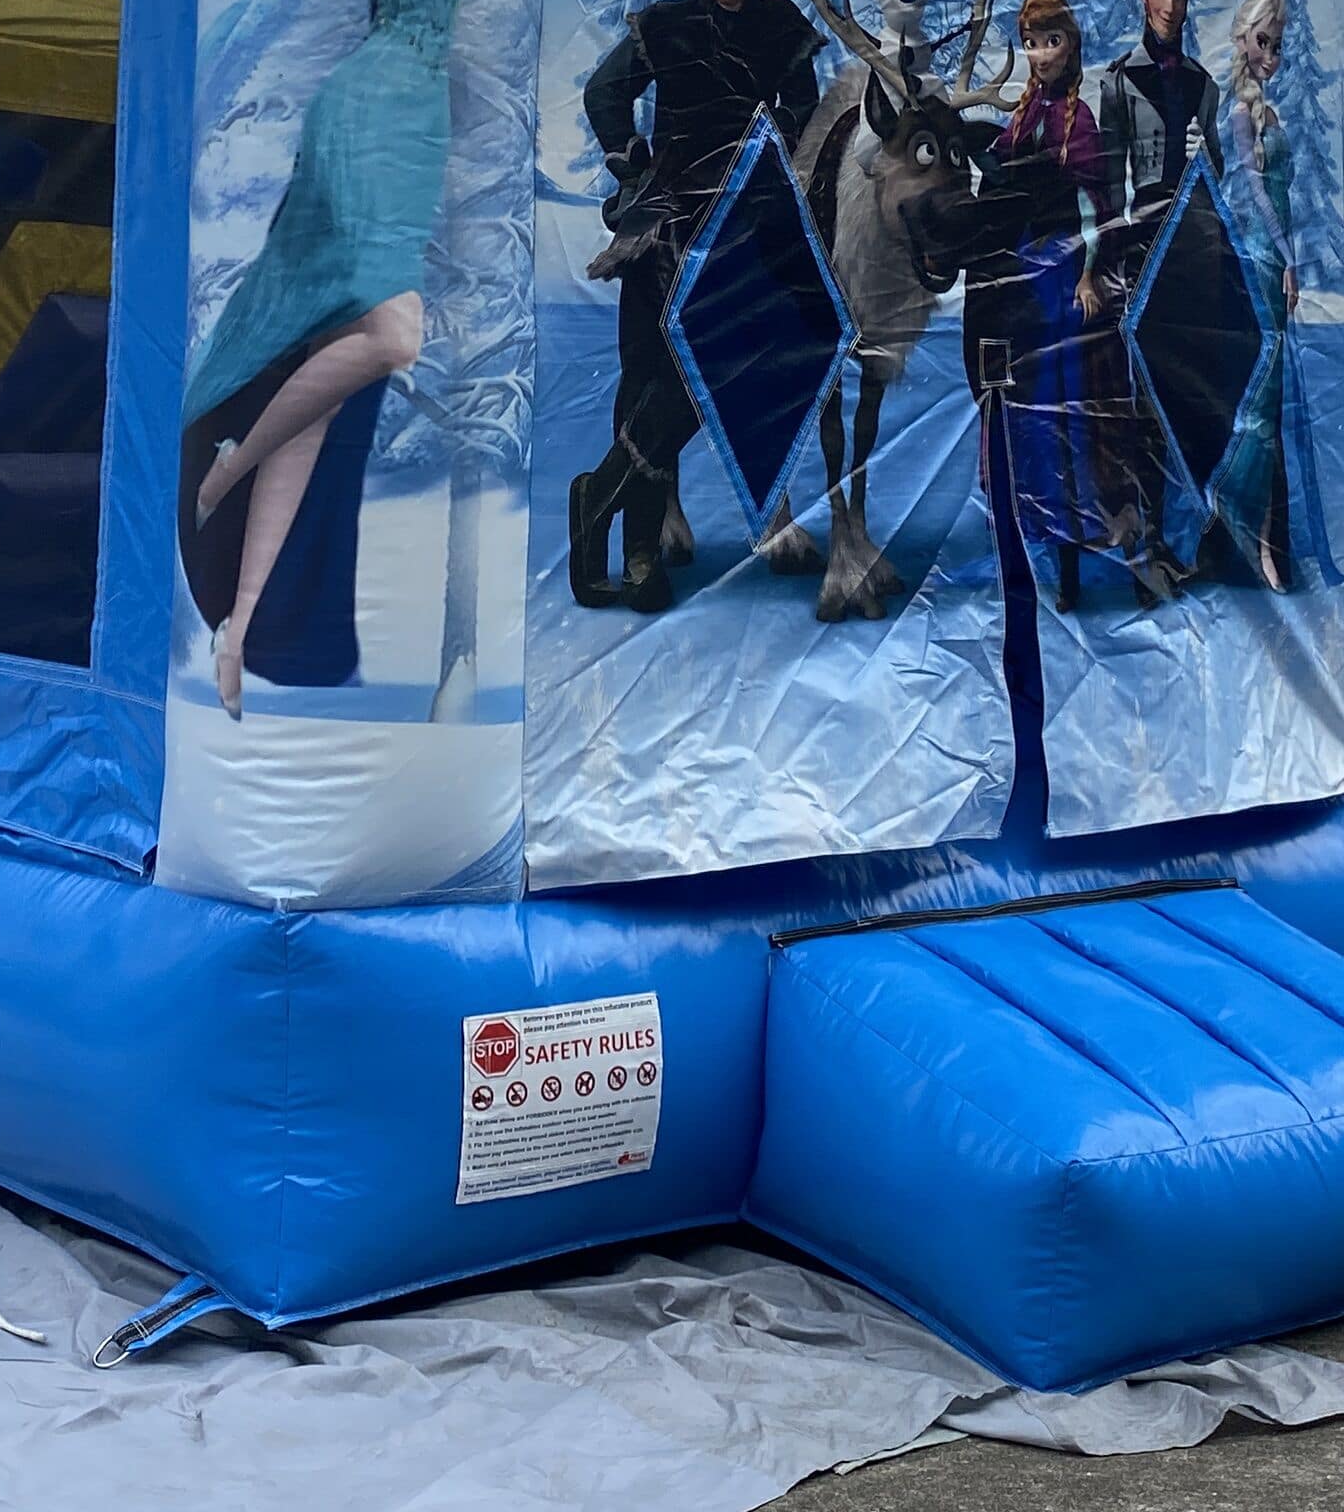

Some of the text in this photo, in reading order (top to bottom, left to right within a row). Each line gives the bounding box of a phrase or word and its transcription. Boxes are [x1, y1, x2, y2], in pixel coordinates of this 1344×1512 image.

[476, 1039, 515, 1058] STOP
[524, 1028, 655, 1065] SAFETY RULES
